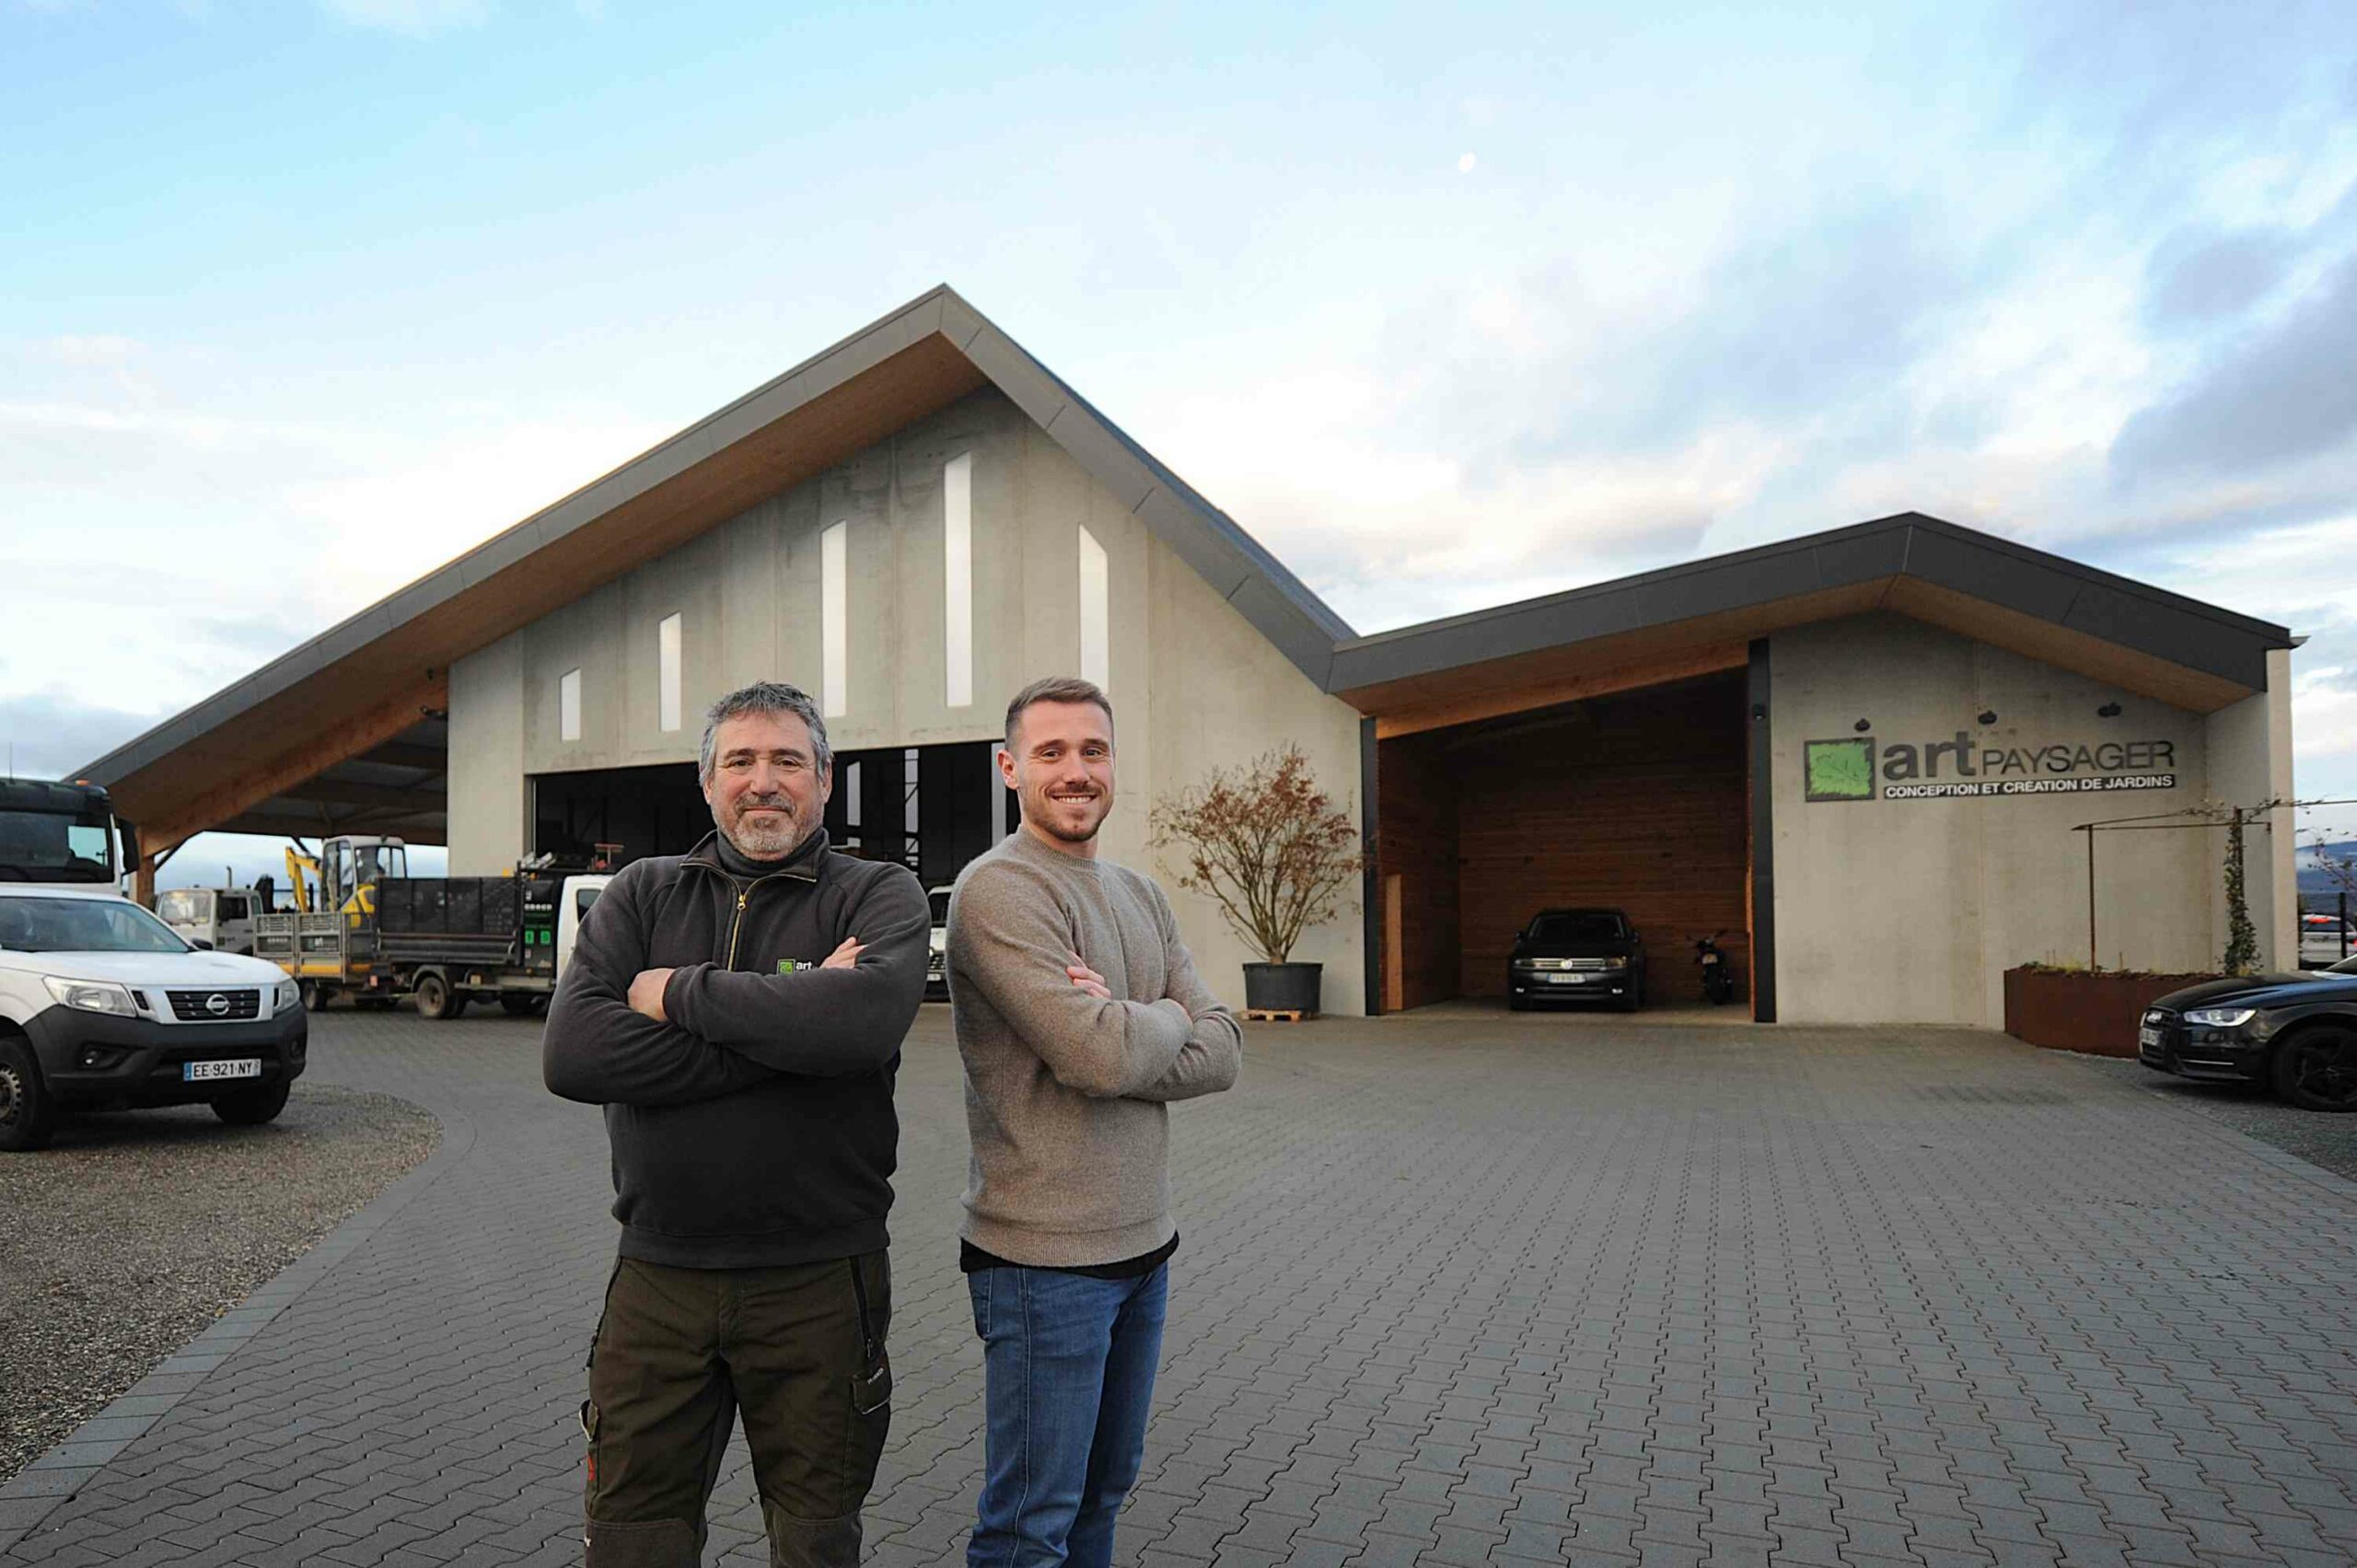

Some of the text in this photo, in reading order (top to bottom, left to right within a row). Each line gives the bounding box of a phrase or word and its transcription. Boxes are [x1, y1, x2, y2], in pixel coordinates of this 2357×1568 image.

[1882, 731, 2175, 781] art PAYSAGER
[1886, 784, 1979, 797] CONCEPTION
[1981, 783, 2001, 794] ET
[2081, 778, 2103, 790] DE
[2105, 775, 2173, 788] JARDINS
[795, 961, 812, 970] art
